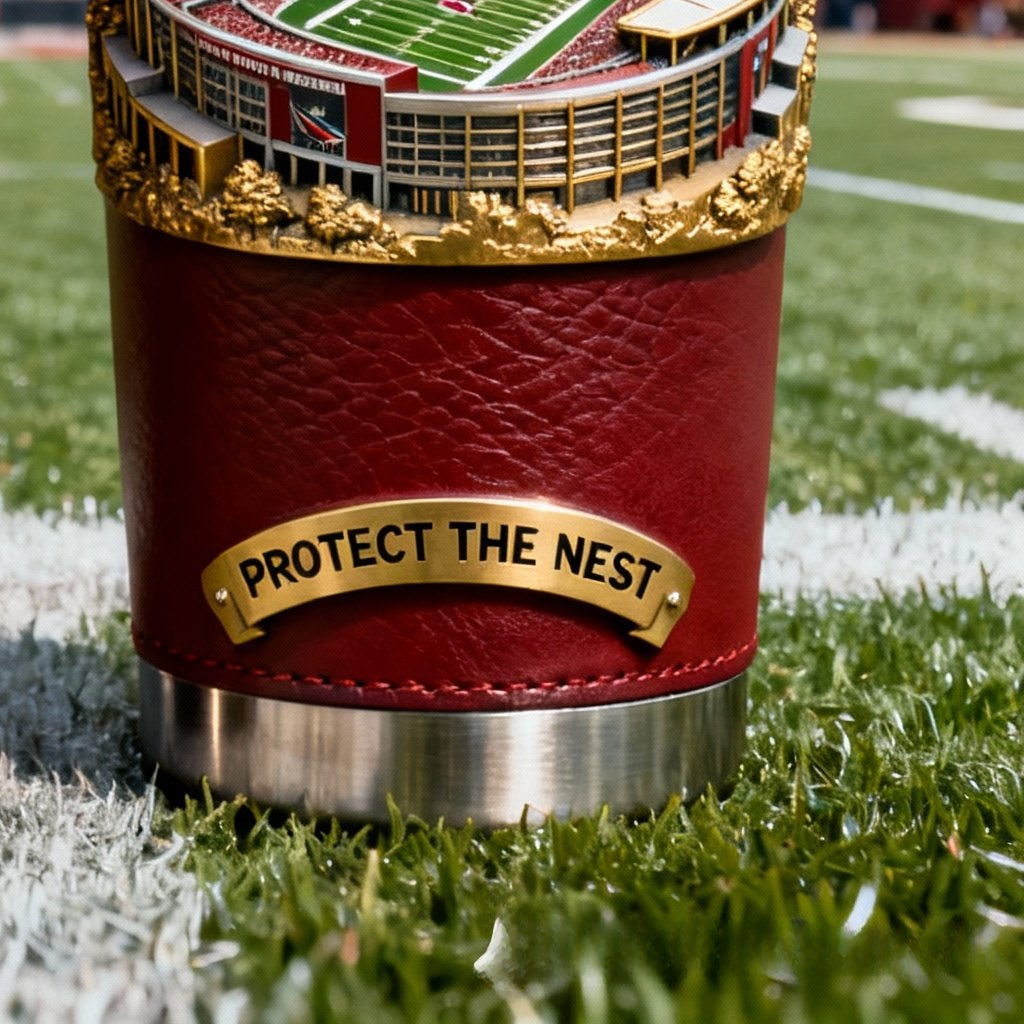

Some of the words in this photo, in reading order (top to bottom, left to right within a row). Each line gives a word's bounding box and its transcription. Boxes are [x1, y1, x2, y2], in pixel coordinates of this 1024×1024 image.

[239, 522, 433, 599] PROTECT
[449, 521, 539, 566] THE
[554, 533, 663, 600] NEST
